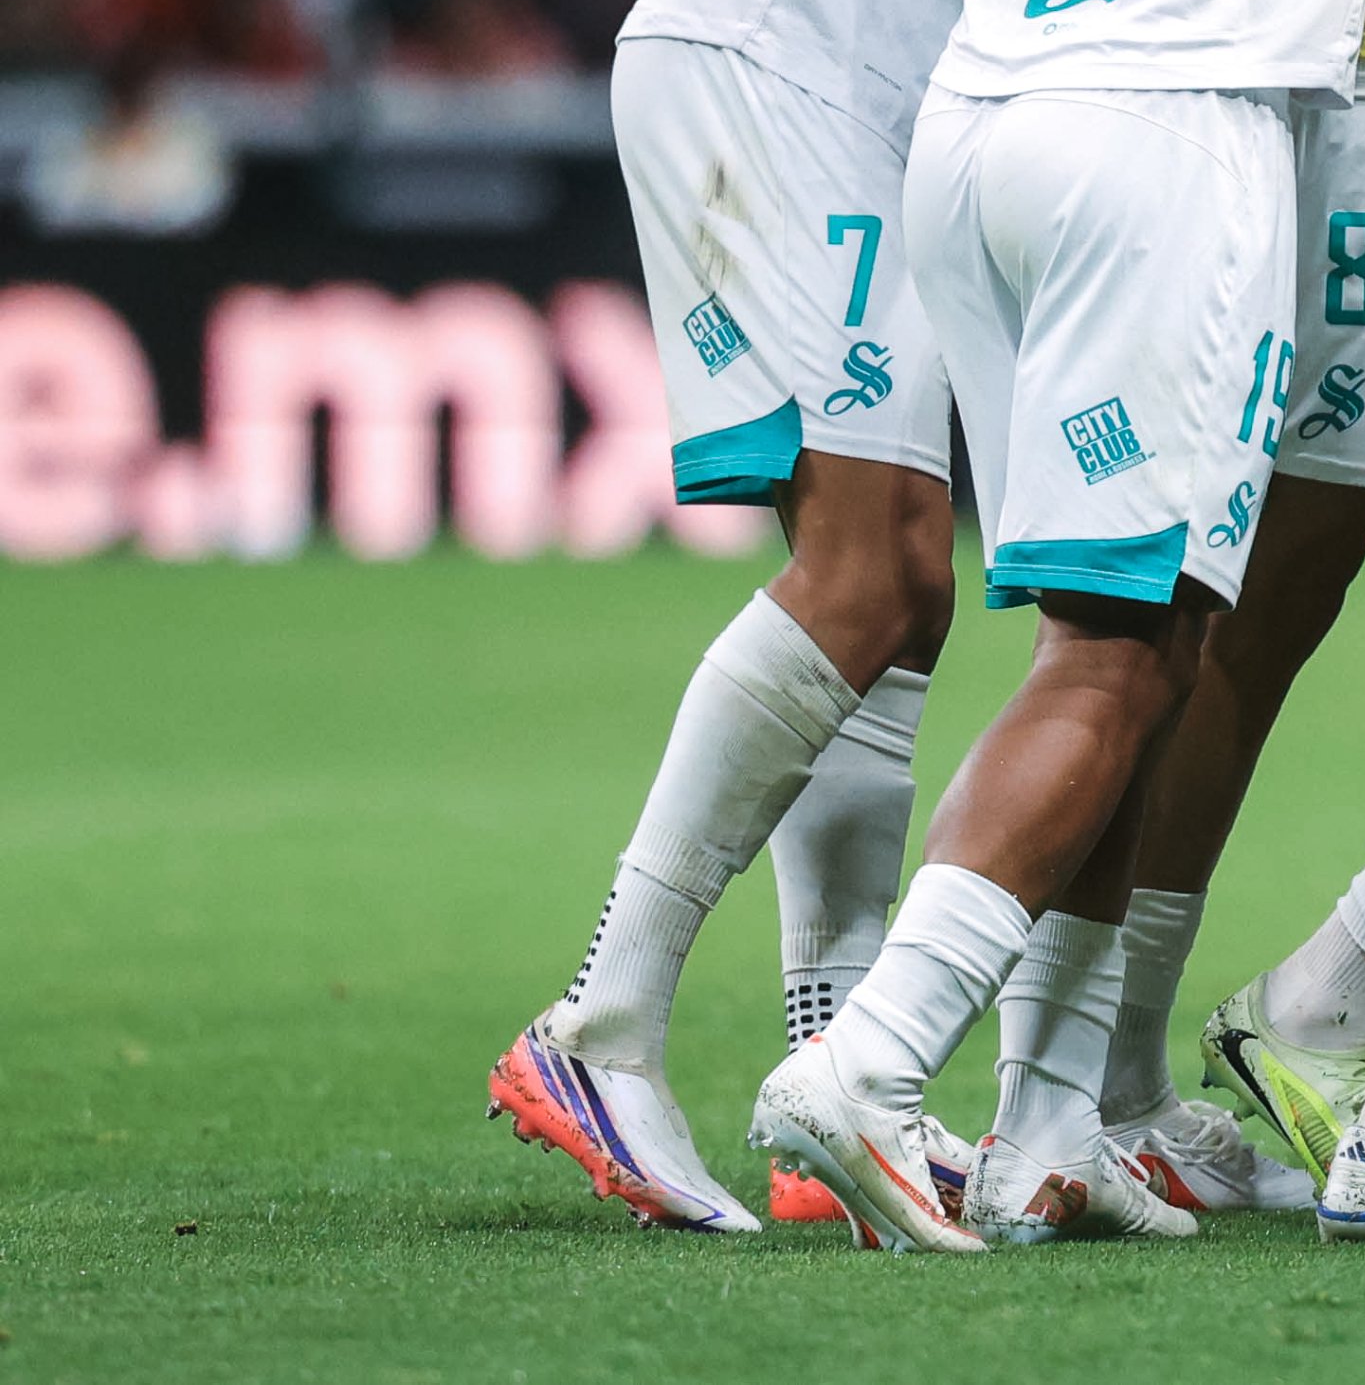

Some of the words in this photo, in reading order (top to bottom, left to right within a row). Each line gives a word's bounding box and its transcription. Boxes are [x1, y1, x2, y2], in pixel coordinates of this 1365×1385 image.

[827, 215, 882, 327] 7
[1067, 401, 1123, 447] CITY
[1077, 428, 1140, 474] CLUB
